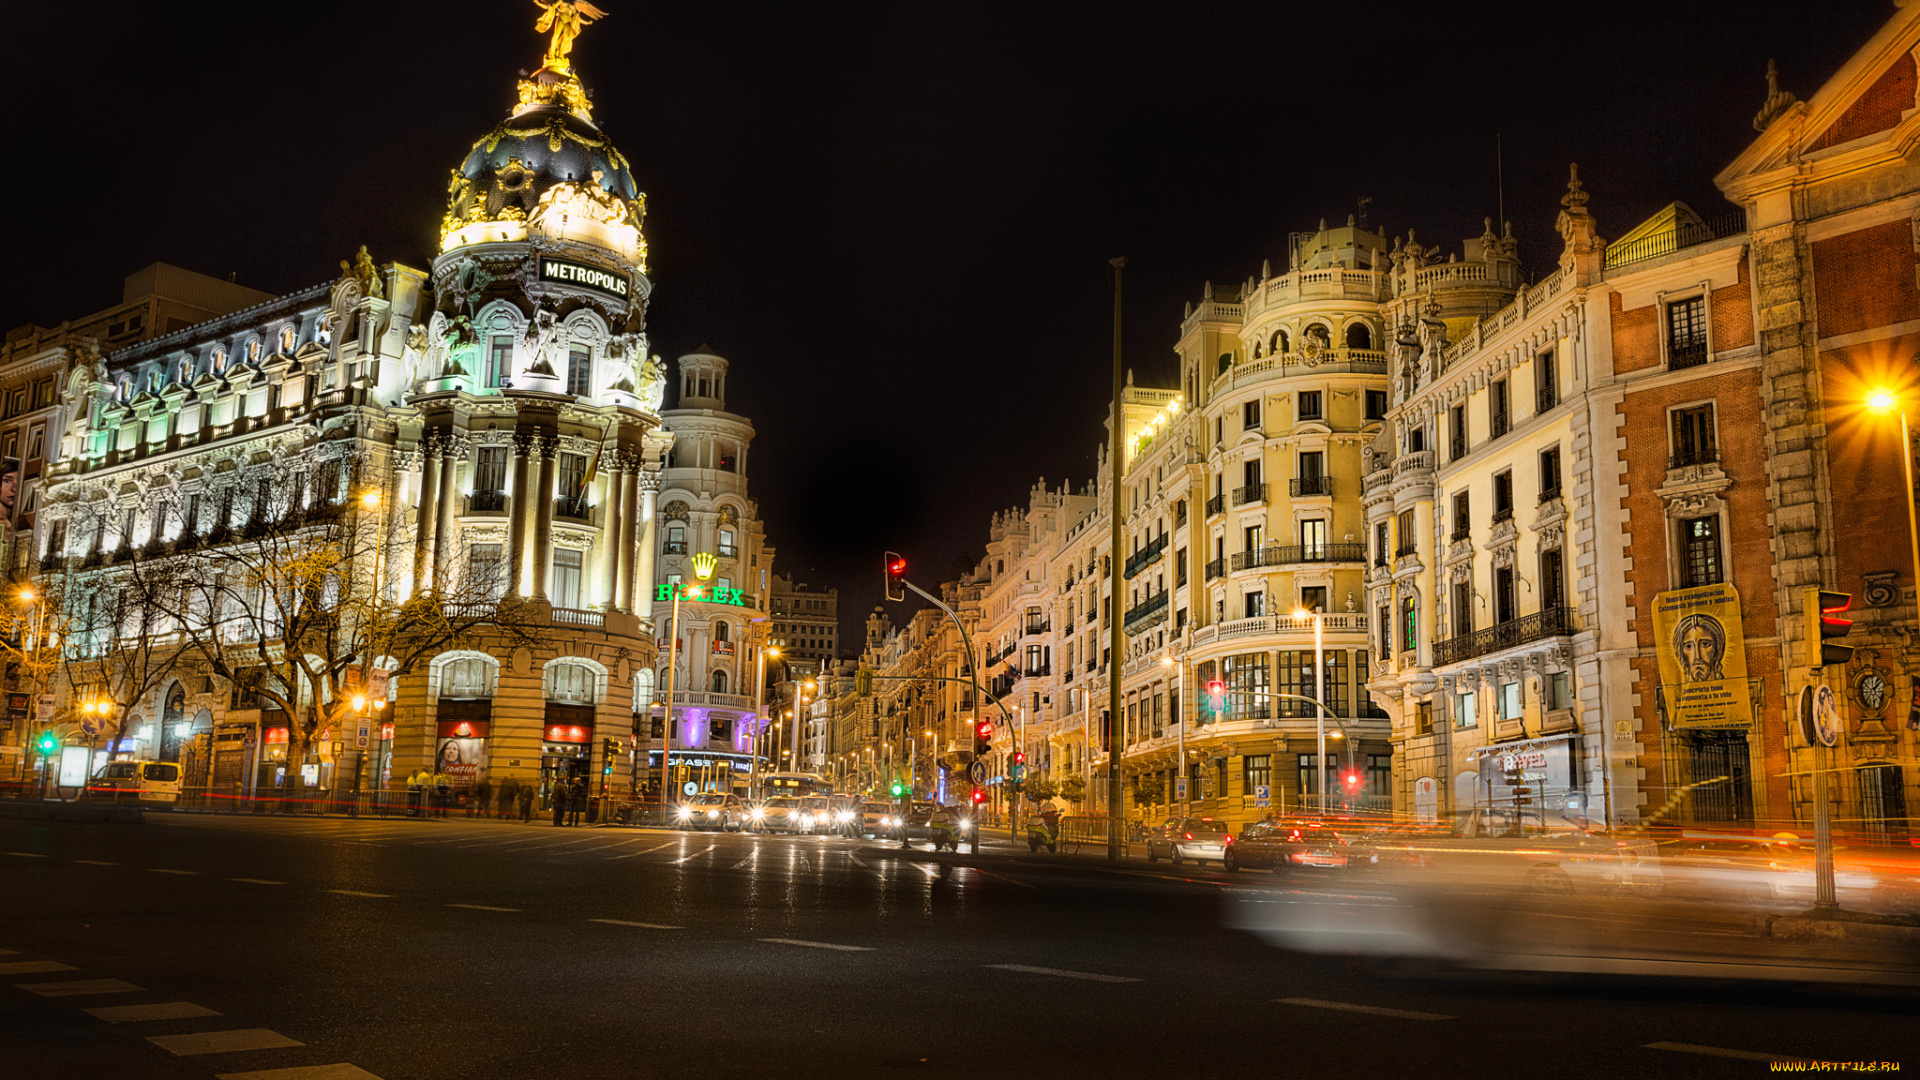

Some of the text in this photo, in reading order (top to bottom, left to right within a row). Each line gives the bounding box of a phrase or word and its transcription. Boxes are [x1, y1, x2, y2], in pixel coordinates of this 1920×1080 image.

[545, 262, 627, 295] METROPOLIS
[656, 584, 745, 606] ROLEX
[667, 758, 714, 767] GRASS
[1256, 788, 1264, 798] P
